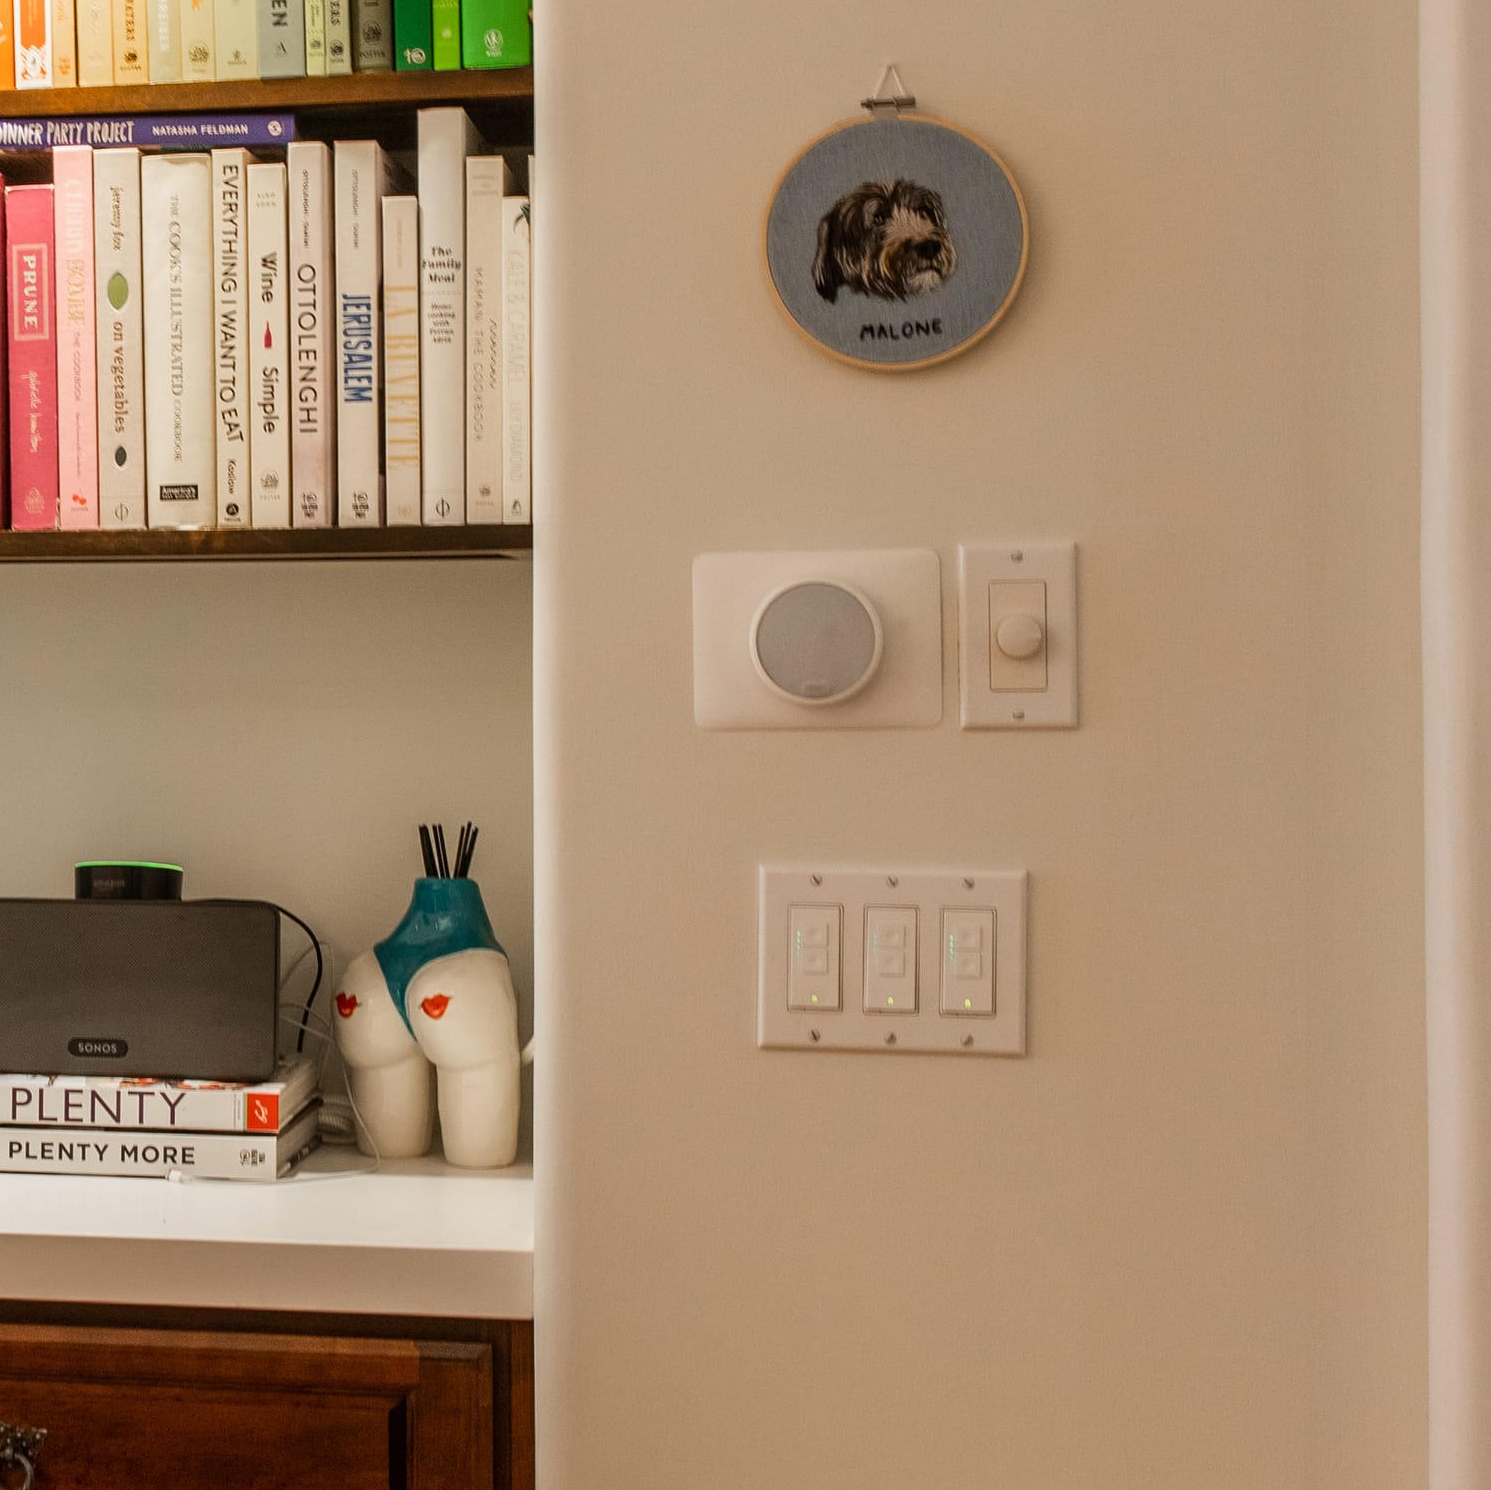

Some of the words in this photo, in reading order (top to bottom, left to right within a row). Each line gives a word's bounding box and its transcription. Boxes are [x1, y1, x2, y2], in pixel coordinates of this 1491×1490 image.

[46, 122, 85, 145] PARTY
[87, 120, 135, 144] PROJECT
[152, 124, 198, 136] NATASHA
[201, 124, 249, 136] FELDMAN
[110, 185, 124, 228] jeremy
[169, 195, 179, 218] THE
[221, 164, 238, 293] EVERYTHING
[112, 231, 124, 251] fox
[169, 221, 182, 284] COOK'S
[22, 254, 38, 330] PRUNE
[66, 260, 86, 327] BOMBE
[260, 252, 278, 303] Wine
[473, 266, 485, 322] MAMAN
[113, 321, 126, 342] on
[169, 287, 183, 396] ILLUSTRATED
[220, 310, 238, 379] WANT
[297, 263, 318, 434] OTTOLENGHI
[341, 293, 373, 403] JERUSALEM
[474, 328, 485, 356] THE
[859, 317, 943, 341] MALONE
[73, 351, 82, 402] COOKBOOK
[110, 346, 128, 434] vegetables
[220, 382, 236, 403] TO
[258, 366, 280, 434] Simple
[221, 409, 244, 443] EAT
[473, 363, 486, 443] COOKBOOK
[173, 399, 183, 461] COOKBOOK
[78, 1042, 117, 1054] SONOS
[10, 1087, 186, 1126] PLENTY
[8, 1141, 110, 1163] PLENTY
[120, 1145, 196, 1166] MORE
